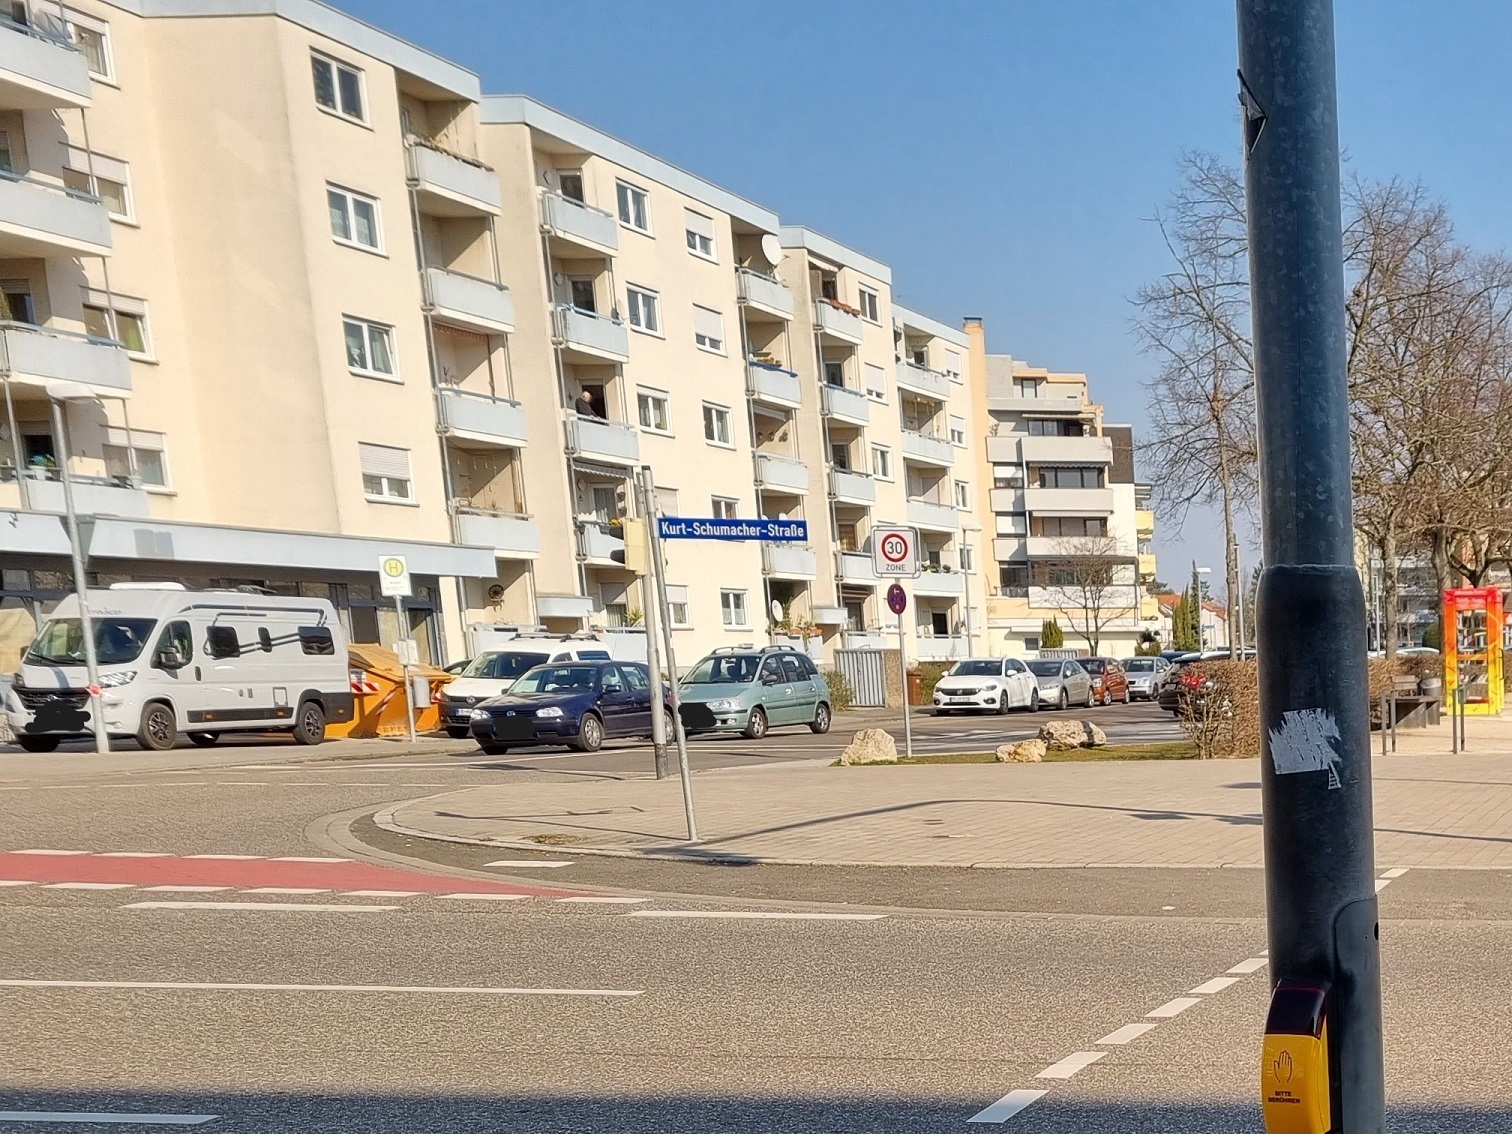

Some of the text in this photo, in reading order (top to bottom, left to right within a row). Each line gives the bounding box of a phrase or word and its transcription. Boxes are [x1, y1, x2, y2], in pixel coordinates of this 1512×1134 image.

[661, 521, 804, 537] Kurt-Schumacher-Straße
[886, 541, 903, 555] 30
[885, 563, 906, 572] ZONE
[1267, 1096, 1301, 1104] BERÜHREN
